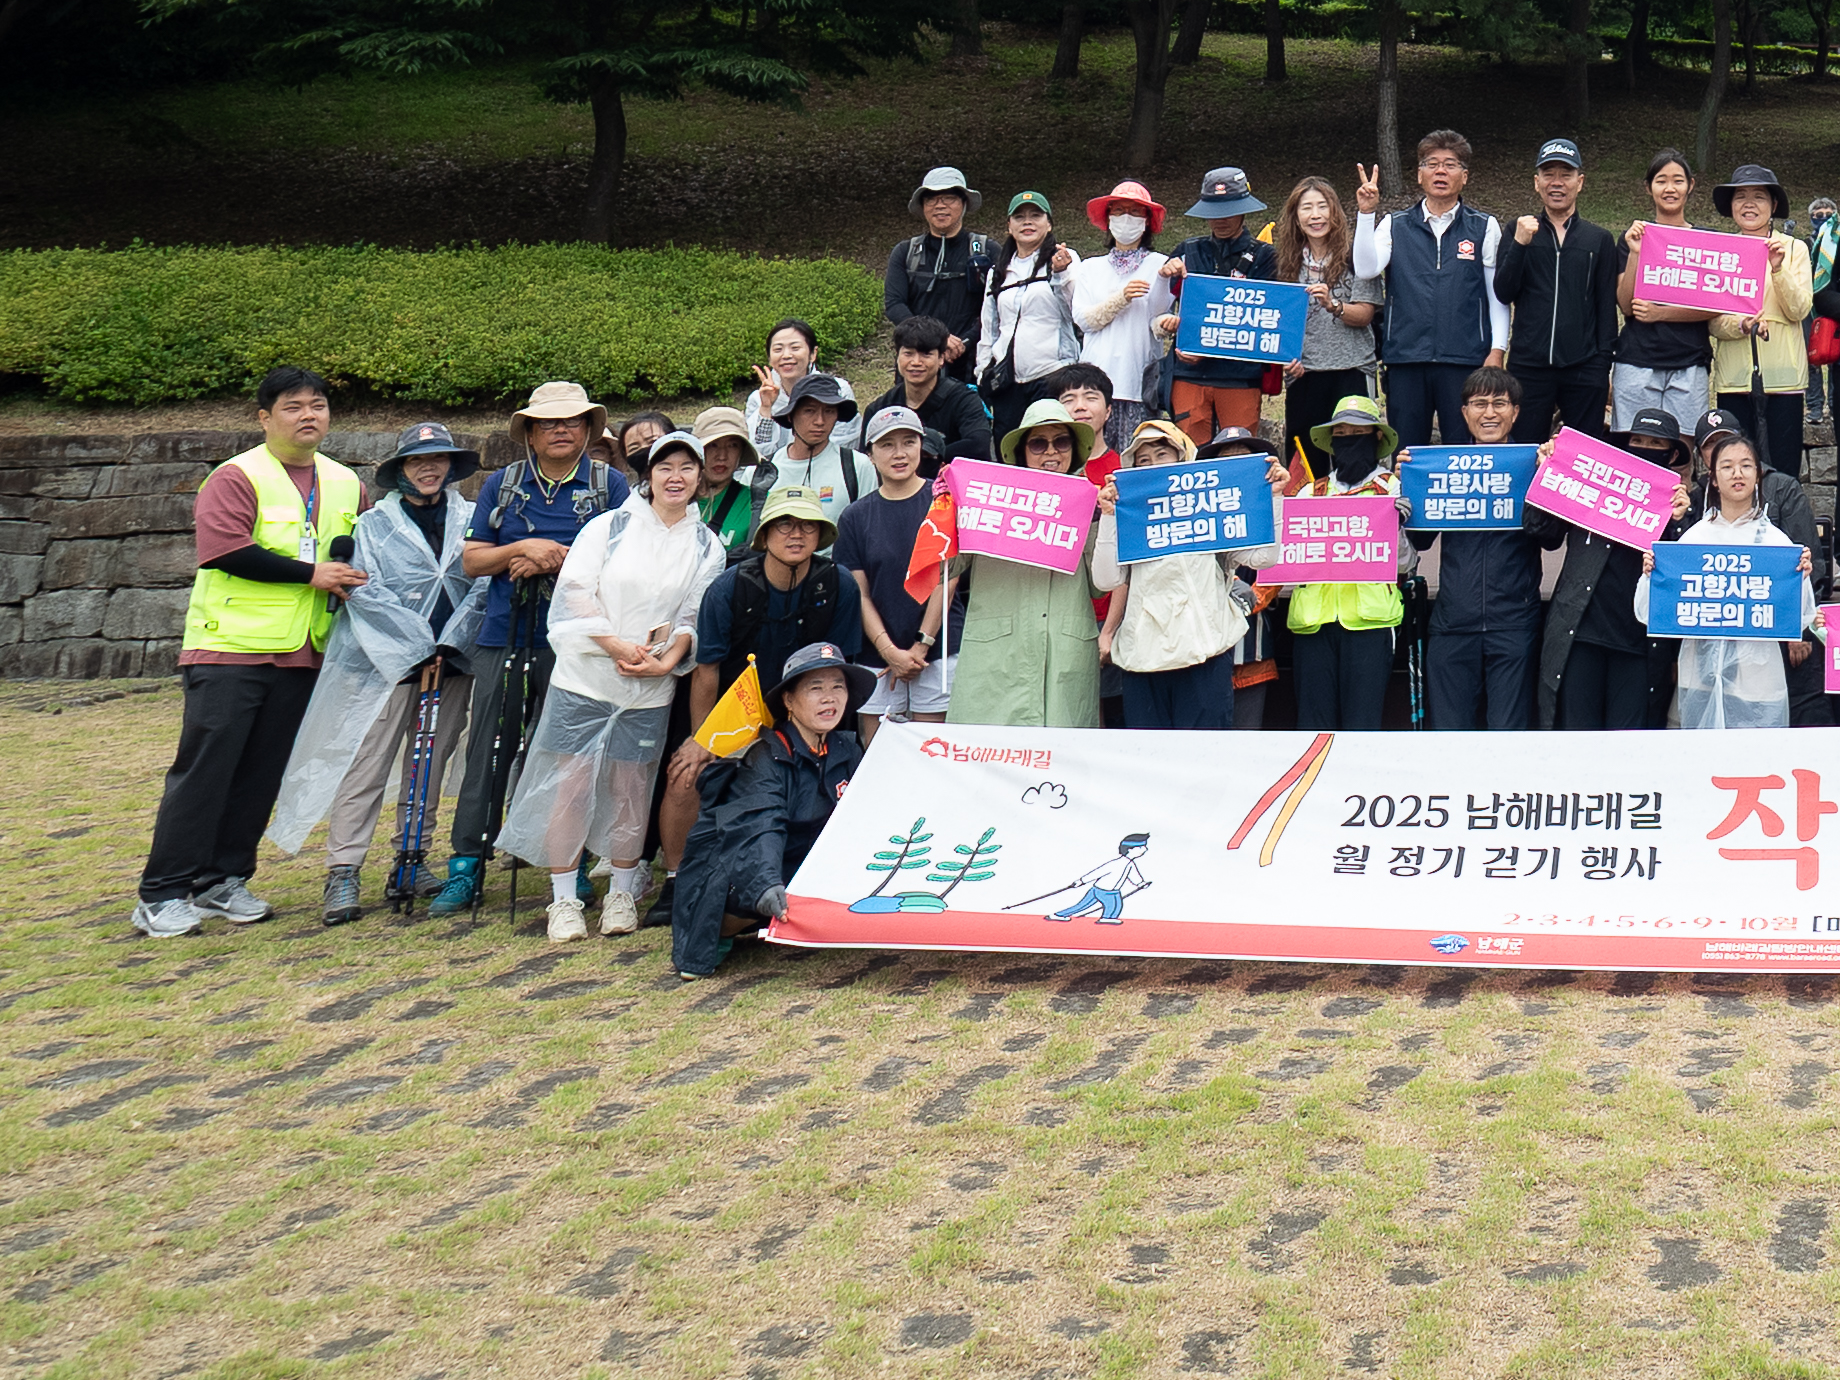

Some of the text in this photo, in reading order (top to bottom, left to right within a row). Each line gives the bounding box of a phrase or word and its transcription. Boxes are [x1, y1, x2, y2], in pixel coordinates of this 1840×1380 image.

[1665, 244, 1743, 274] 국민고향,
[1643, 265, 1758, 298] 남해로 오시다
[1223, 287, 1266, 305] 2025
[1204, 303, 1281, 329] 고향사랑
[1200, 326, 1280, 353] 방문의 해
[1447, 454, 1494, 470] 2025
[1168, 470, 1219, 492] 2025
[1427, 472, 1512, 495] 고향사랑
[1572, 453, 1651, 506] 국민고향,
[965, 480, 1062, 518] 국민고향,
[1147, 487, 1242, 520] 고향사랑
[1424, 498, 1514, 520] 방문의 해
[1540, 467, 1660, 533] 남해로 오시다
[957, 505, 1078, 550] 해로 오시다
[1146, 514, 1247, 549] 방문의 해
[1288, 515, 1373, 538] 국민고향,
[1332, 542, 1391, 563] 오시다
[1702, 553, 1752, 573] 2025
[1680, 574, 1772, 600] 고향사랑
[1676, 601, 1774, 628] 방문의 해
[953, 743, 1051, 769] 남해바래길
[1340, 792, 1662, 830] 2025 남해바래길
[1333, 844, 1662, 880] 월 정기 걷기 행사
[1478, 936, 1524, 950] 남해군
